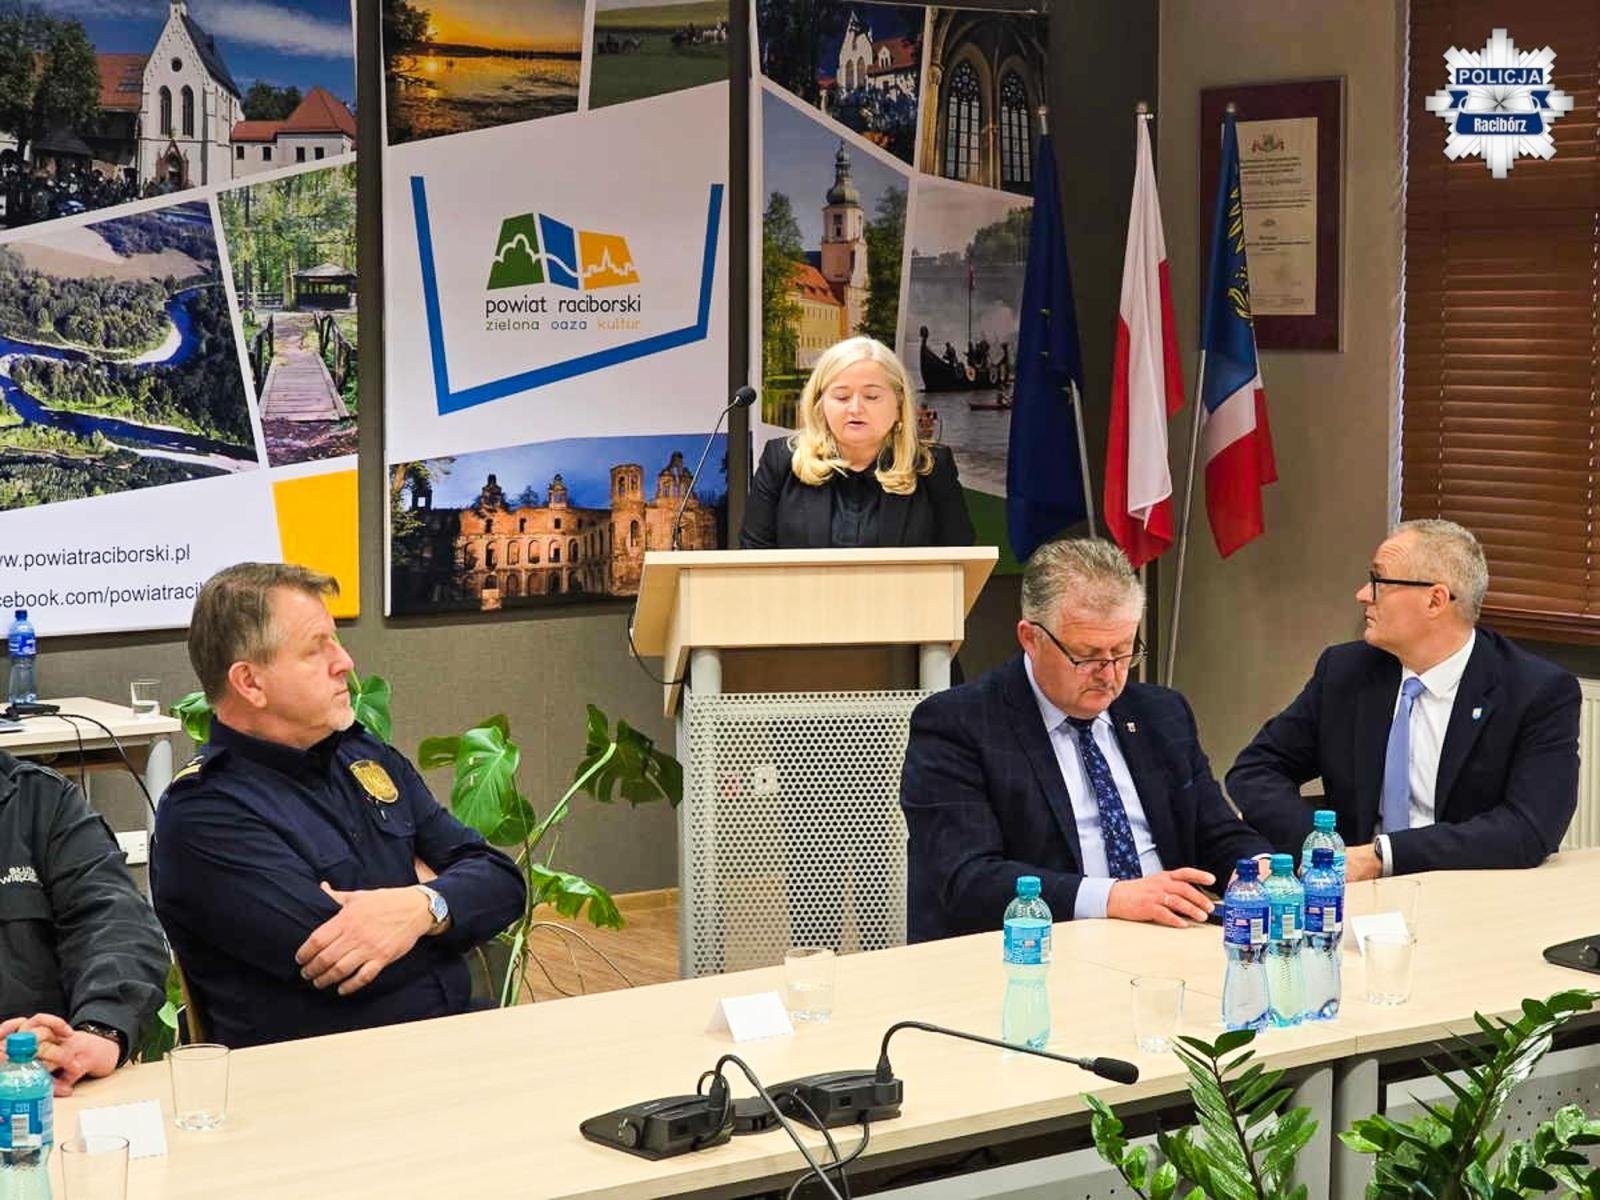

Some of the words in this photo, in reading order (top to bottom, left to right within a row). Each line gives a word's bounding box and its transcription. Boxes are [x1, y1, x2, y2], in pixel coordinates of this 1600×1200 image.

[485, 294, 548, 318] powiat
[558, 293, 641, 313] raciborski
[485, 318, 540, 331] zielona
[551, 320, 588, 331] oaza
[597, 318, 641, 330] kultur
[0, 581, 203, 609] ebook.com/powiatraci
